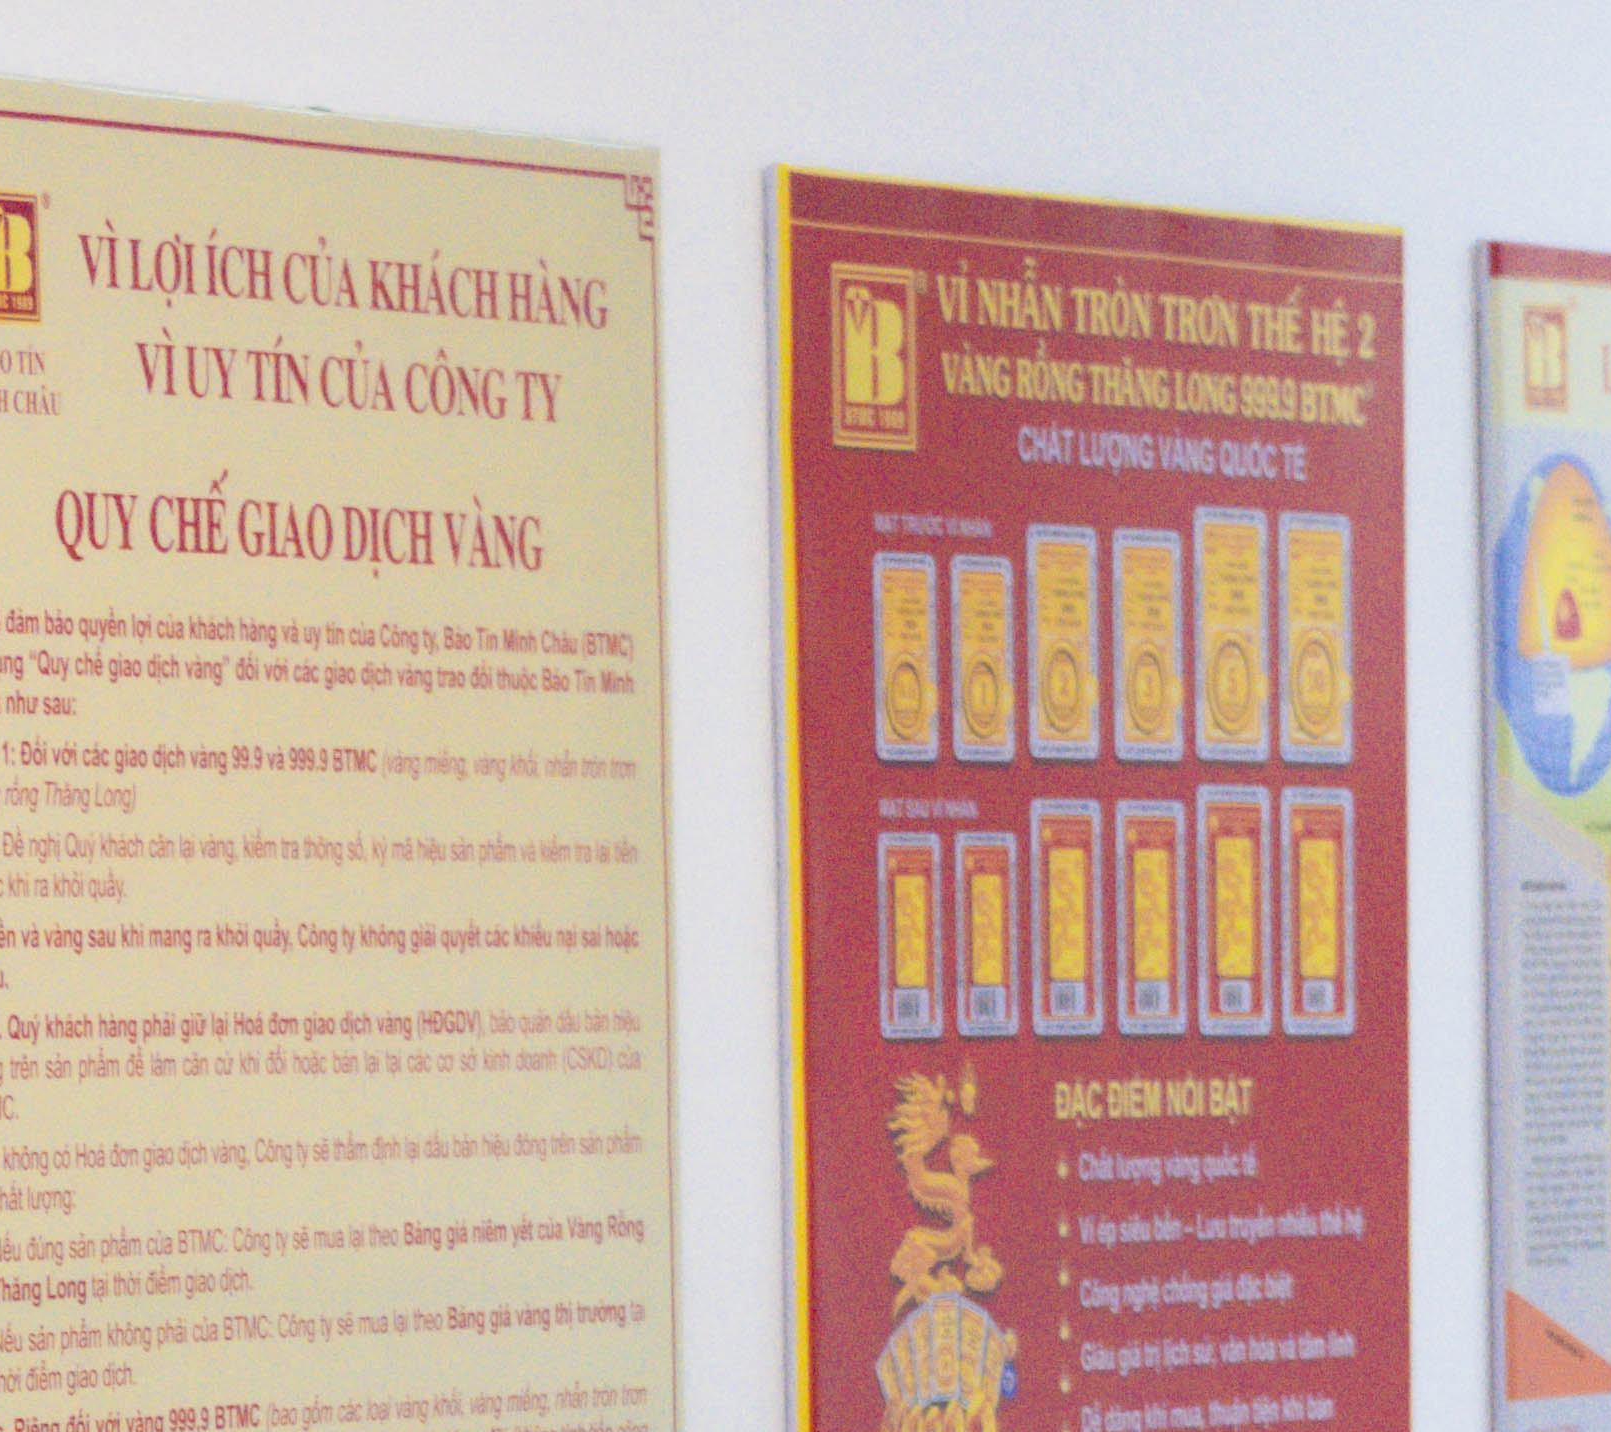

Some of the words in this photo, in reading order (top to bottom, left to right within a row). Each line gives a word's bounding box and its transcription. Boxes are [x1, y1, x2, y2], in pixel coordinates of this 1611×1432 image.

[78, 219, 118, 291] VÌ
[130, 233, 194, 311] LỢI
[207, 227, 270, 299] ÍCH
[284, 235, 358, 307] CỦA
[370, 248, 500, 319] KHÁCH
[509, 259, 608, 329] HÀNG
[137, 327, 176, 396] VÌ
[189, 347, 236, 402] UY
[247, 335, 309, 404] TÍN
[320, 339, 393, 412] CỦA
[406, 349, 505, 419] CÔNG
[516, 372, 561, 423] TY
[1359, 312, 1375, 360] 2
[13, 384, 63, 419] CHÂU
[942, 342, 1011, 398] VÀNG
[1017, 340, 1083, 402] RỒNG
[1175, 368, 1235, 419] LONG
[1303, 380, 1367, 428] BTMC
[57, 488, 137, 562] QUY
[150, 469, 227, 555] CHẾ
[239, 501, 333, 561] GIAO
[344, 506, 434, 578] DỊCH
[444, 495, 543, 572] VÀNG
[21, 735, 48, 769] Đối
[52, 742, 77, 770] với
[83, 740, 109, 769] các
[114, 742, 148, 774] giao
[153, 742, 184, 774] dịch
[190, 742, 227, 775] vàng
[232, 745, 262, 770] 99.9
[267, 743, 284, 772] và
[289, 746, 328, 773] 999.9
[333, 748, 378, 775] BTMC
